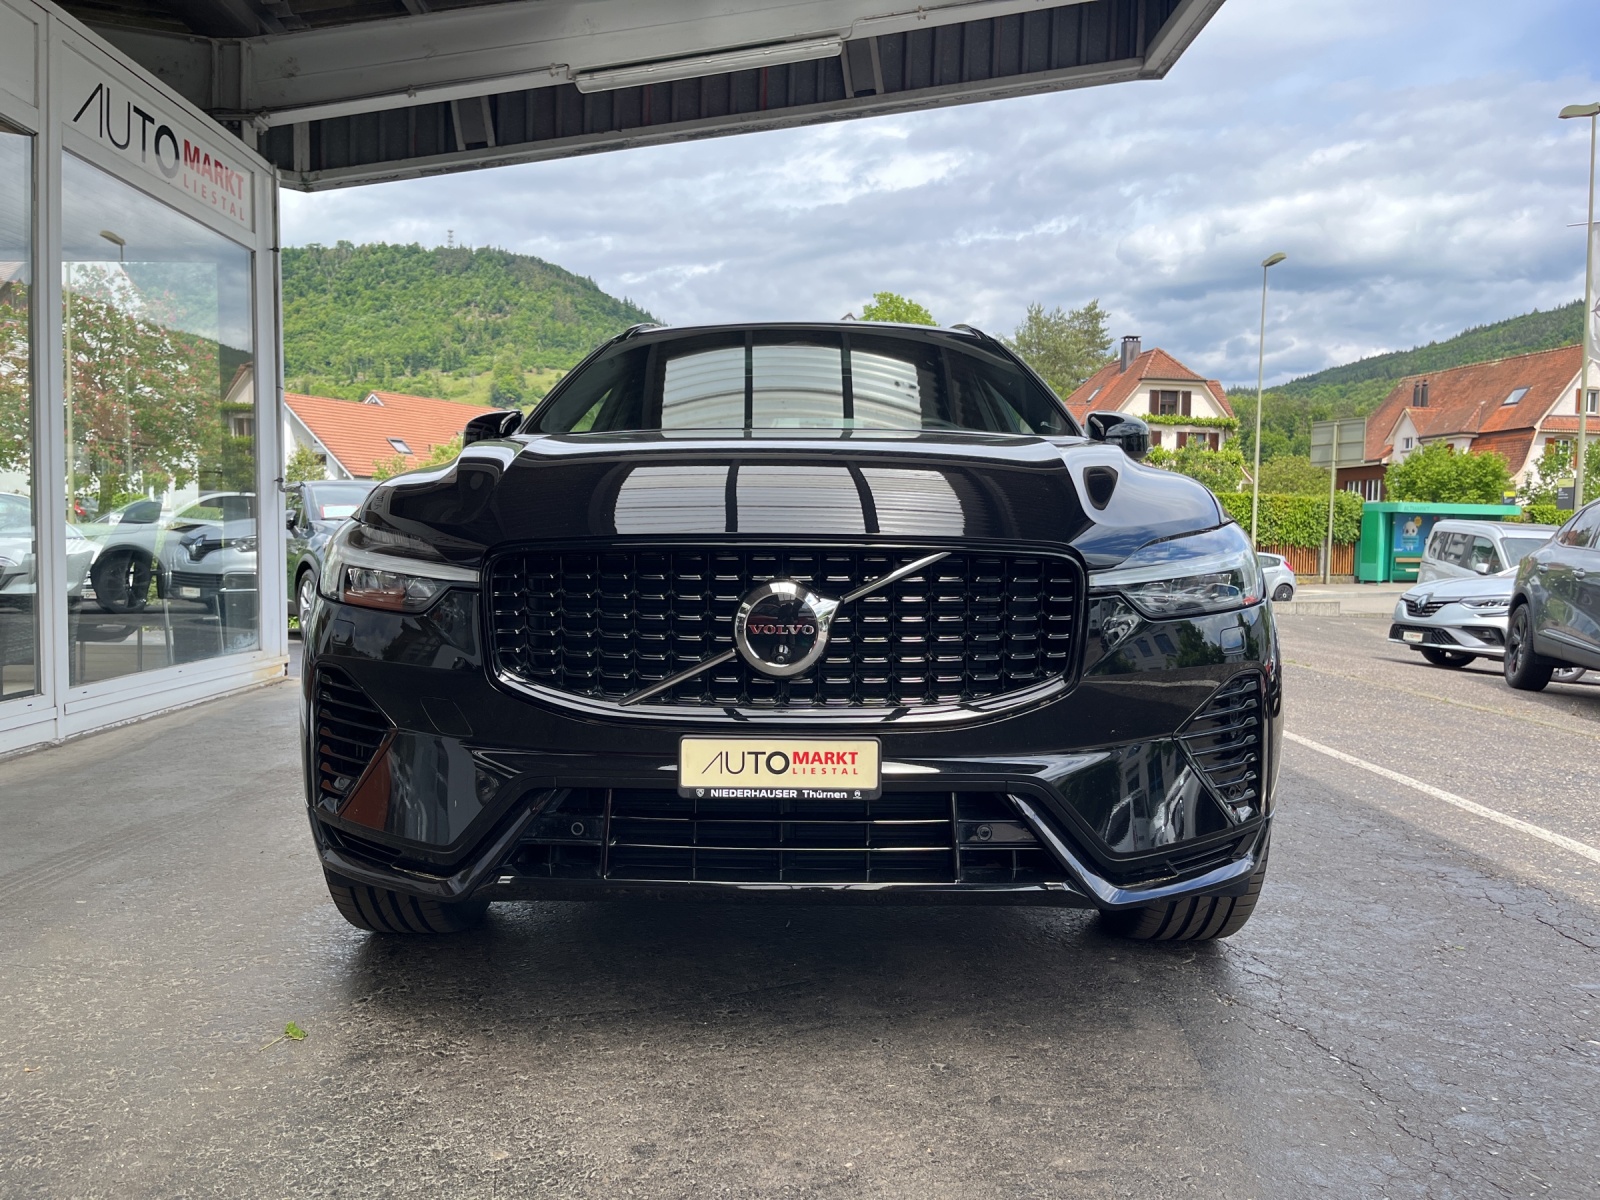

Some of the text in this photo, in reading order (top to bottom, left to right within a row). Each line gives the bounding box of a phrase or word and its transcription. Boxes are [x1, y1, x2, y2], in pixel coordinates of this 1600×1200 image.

[72, 82, 244, 200] AUTO MARKT
[183, 173, 245, 221] LIESTAL
[748, 624, 815, 635] VOLVO
[701, 750, 859, 775] AUTO MARKT
[792, 767, 859, 775] LIESTAL
[710, 789, 848, 799] NIEDERHAUSER Thürnen
